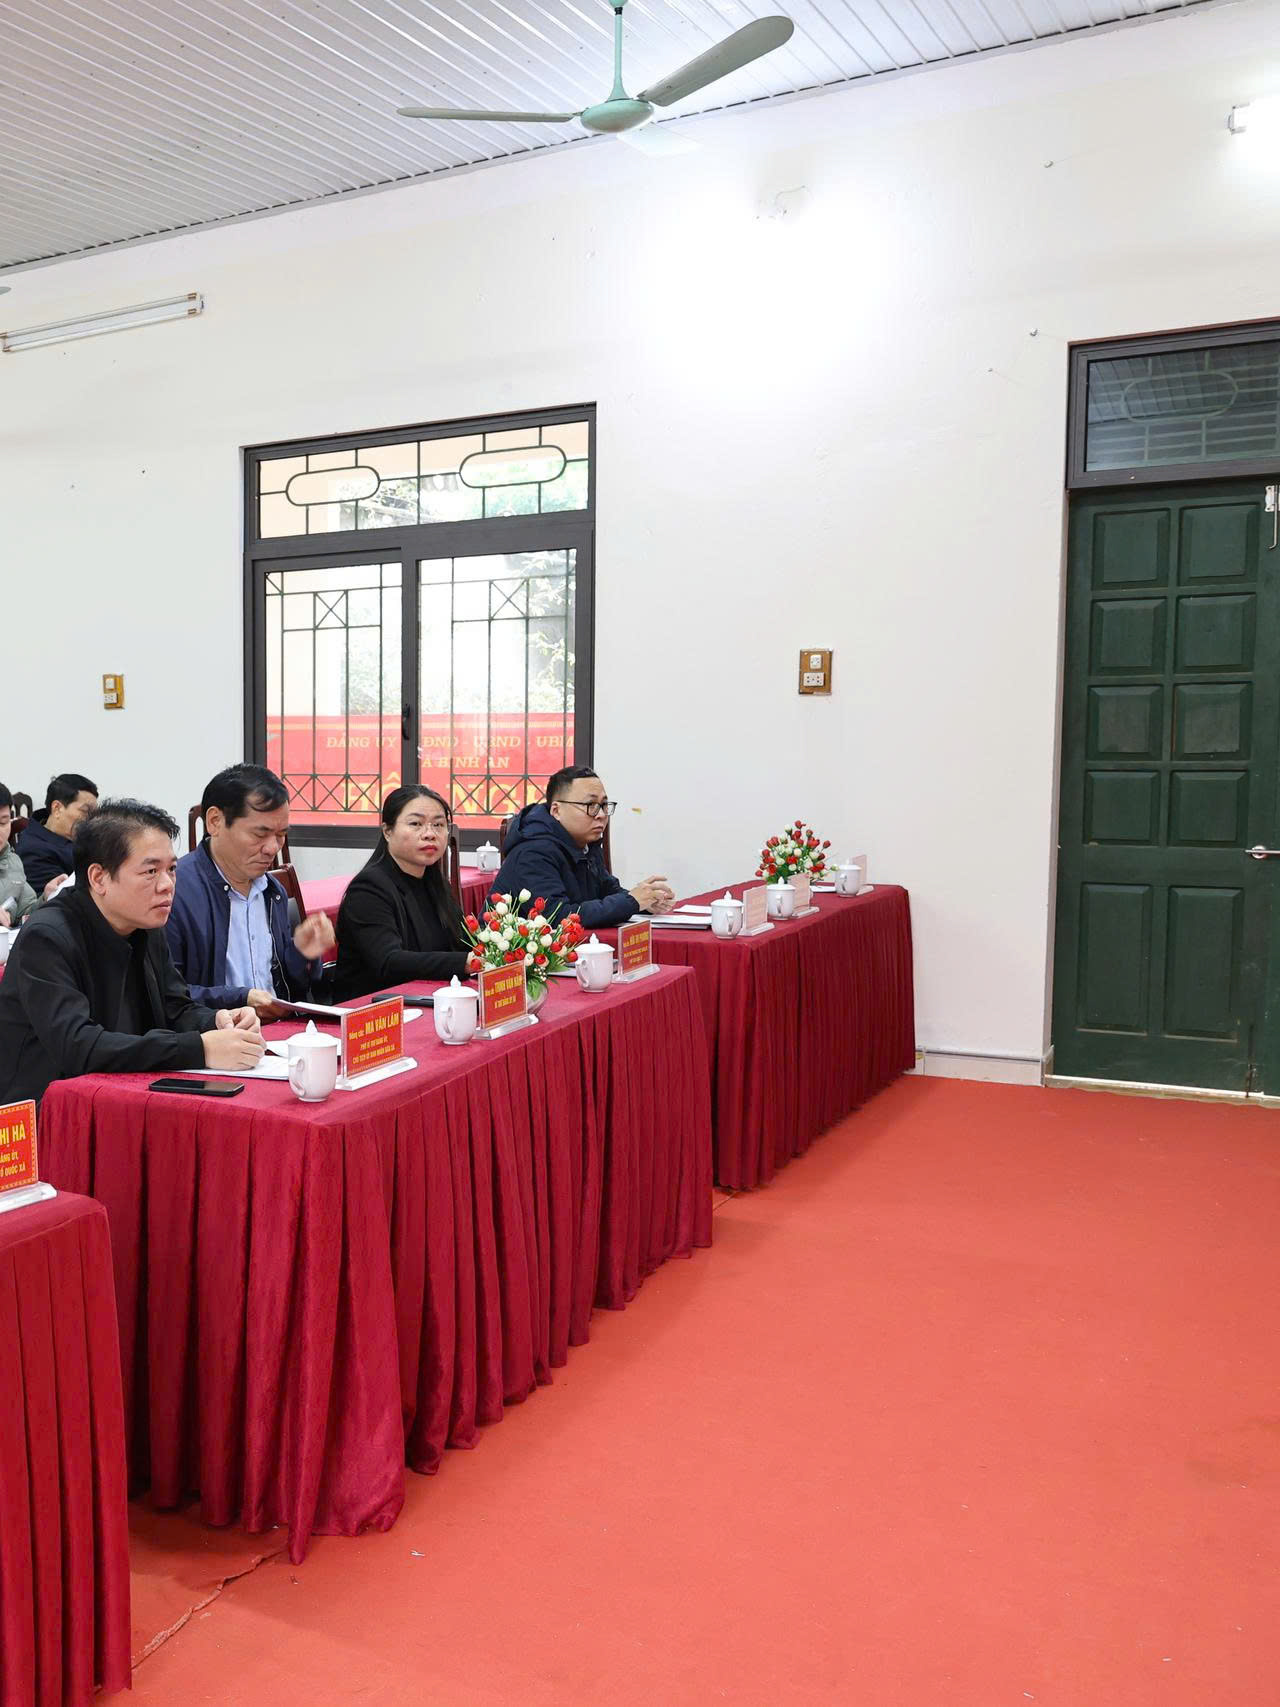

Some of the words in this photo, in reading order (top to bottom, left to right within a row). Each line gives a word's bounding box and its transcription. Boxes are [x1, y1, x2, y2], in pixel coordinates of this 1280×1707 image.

[423, 736, 458, 748] ĐND
[365, 1020, 374, 1034] MA
[12, 1120, 26, 1142] HÀ
